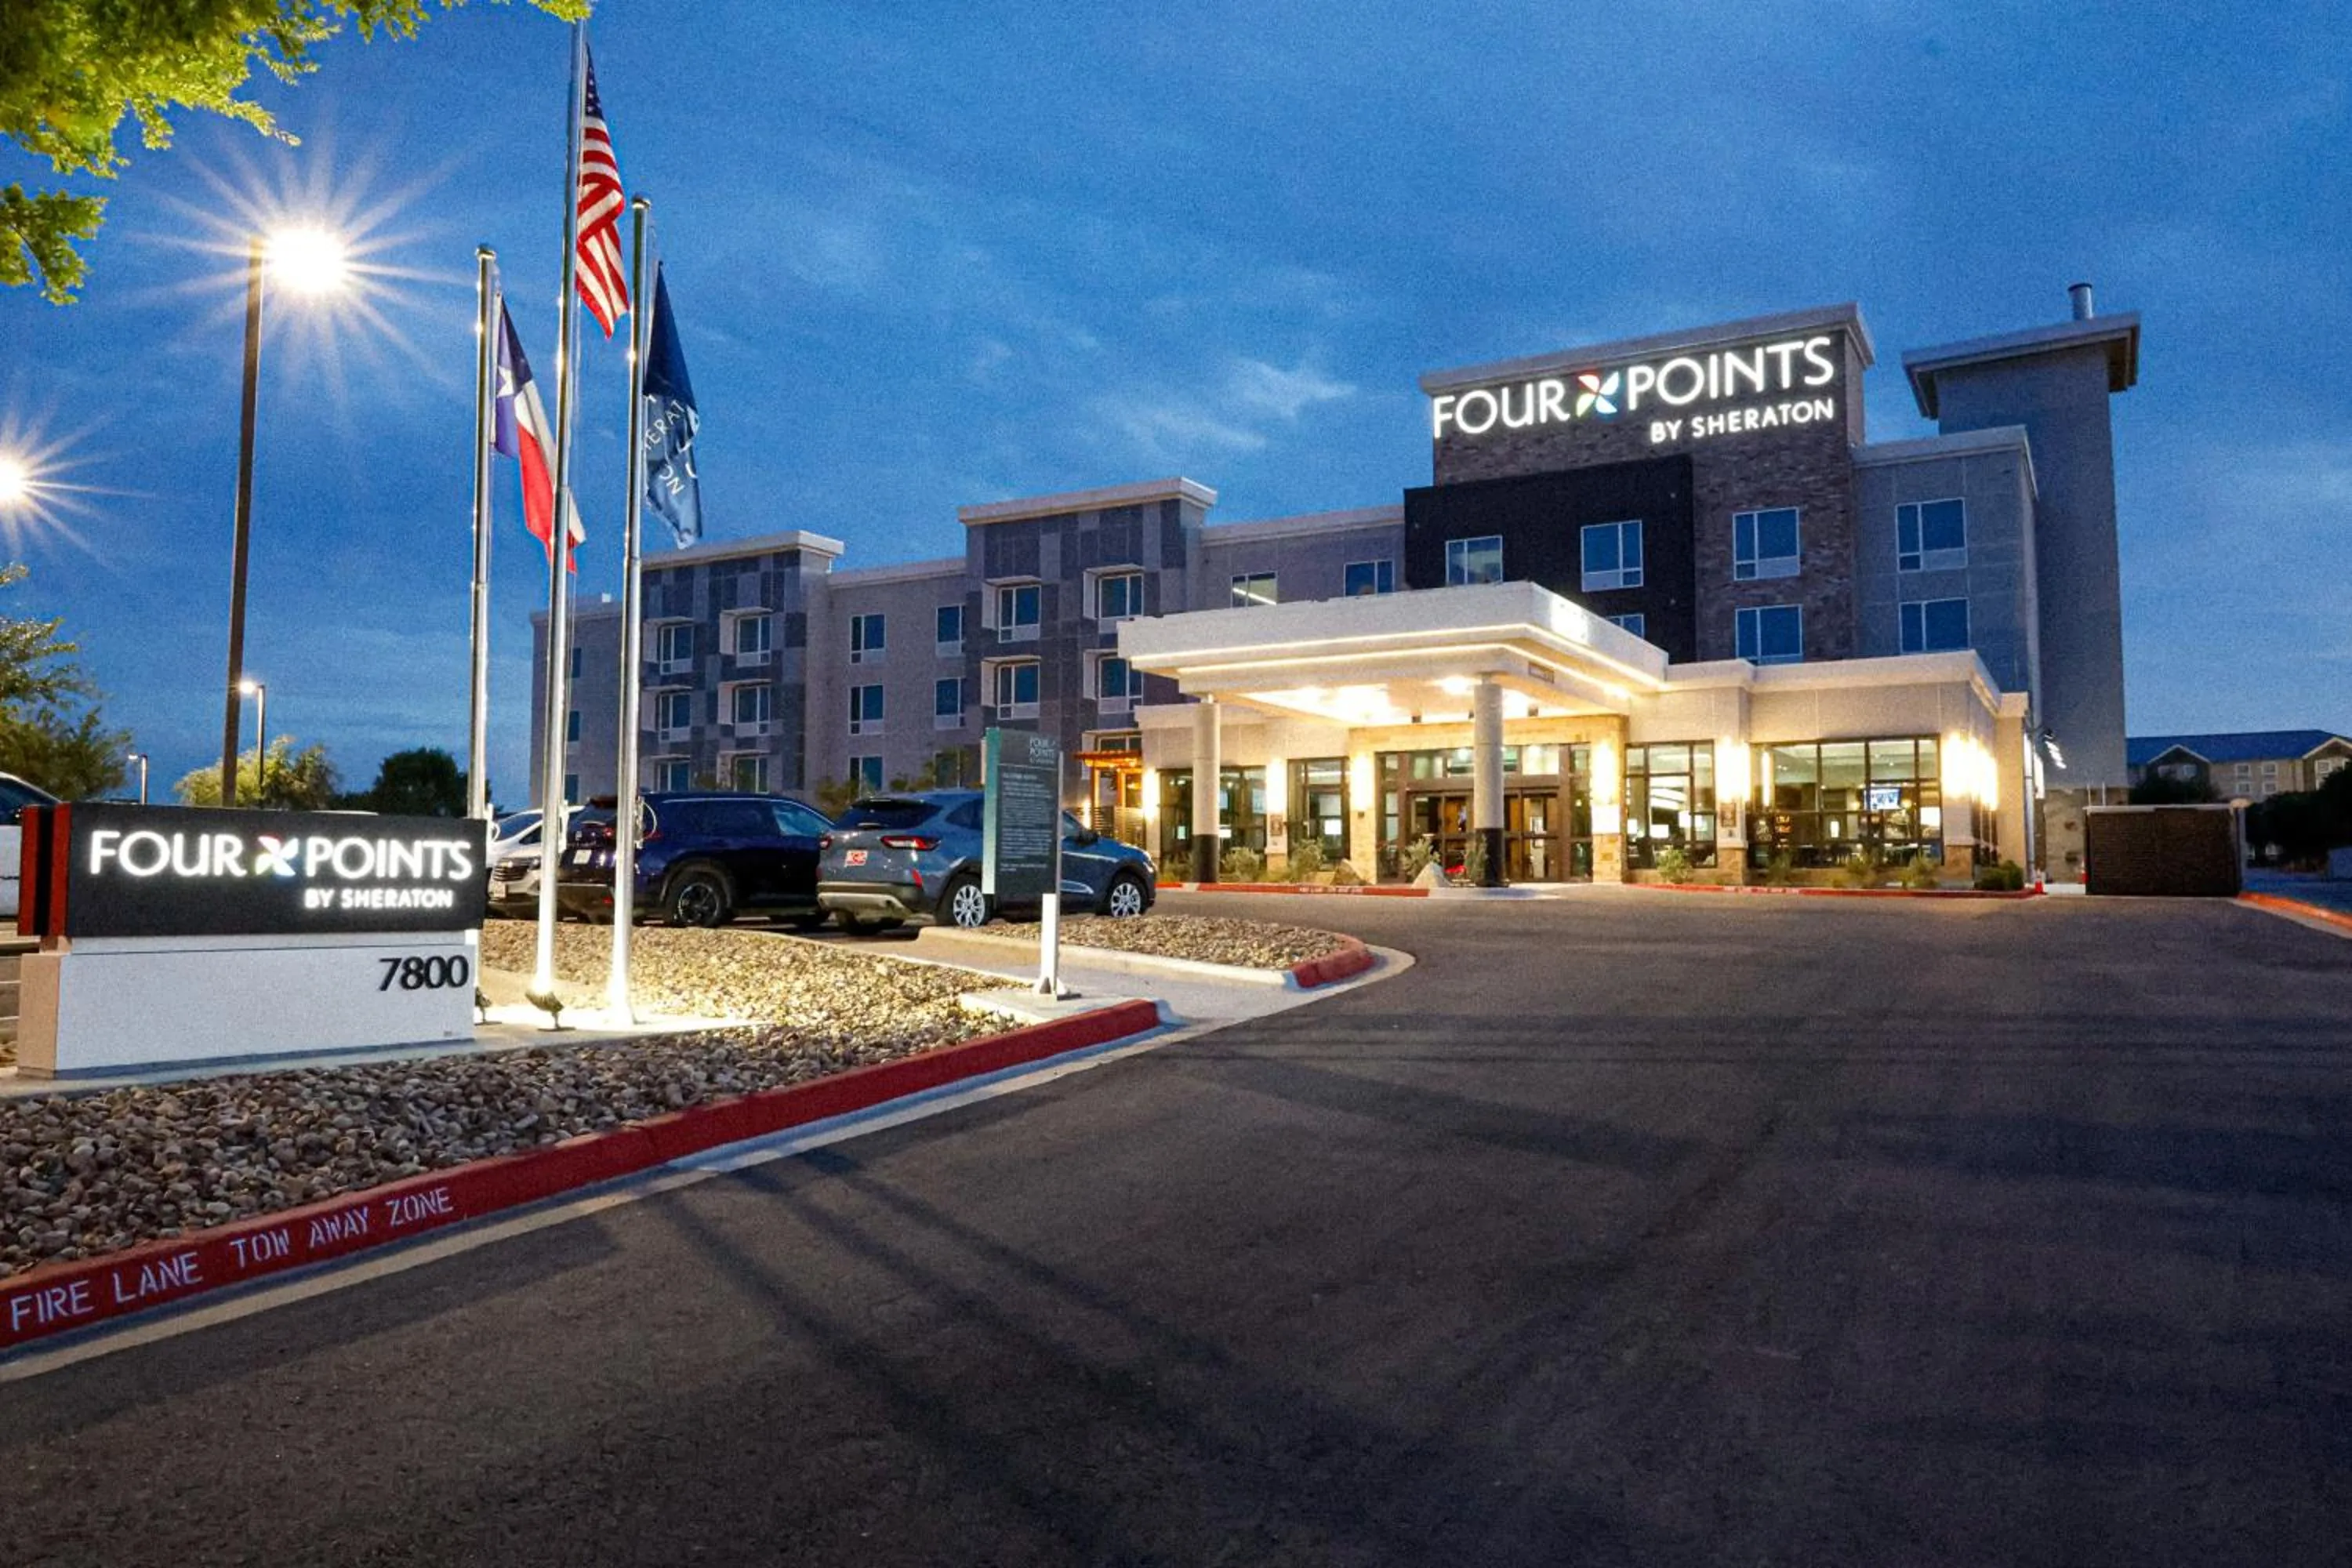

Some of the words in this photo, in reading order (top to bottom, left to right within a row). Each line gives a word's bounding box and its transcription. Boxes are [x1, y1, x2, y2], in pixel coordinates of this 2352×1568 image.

[1433, 379, 1570, 438] FOUR
[1627, 336, 1835, 411] POINTS
[1650, 419, 1682, 444] BY
[1692, 397, 1835, 437] SHERATON
[90, 830, 247, 877] FOUR
[305, 837, 473, 880] POINTS
[304, 888, 335, 909] BY
[341, 888, 453, 909] SHERATON
[379, 954, 469, 992] 7800
[10, 1280, 94, 1331] FIRE
[113, 1251, 204, 1305] LANE
[230, 1233, 291, 1269] TOW
[309, 1207, 370, 1246] AWAY
[385, 1186, 453, 1227] ZONE
